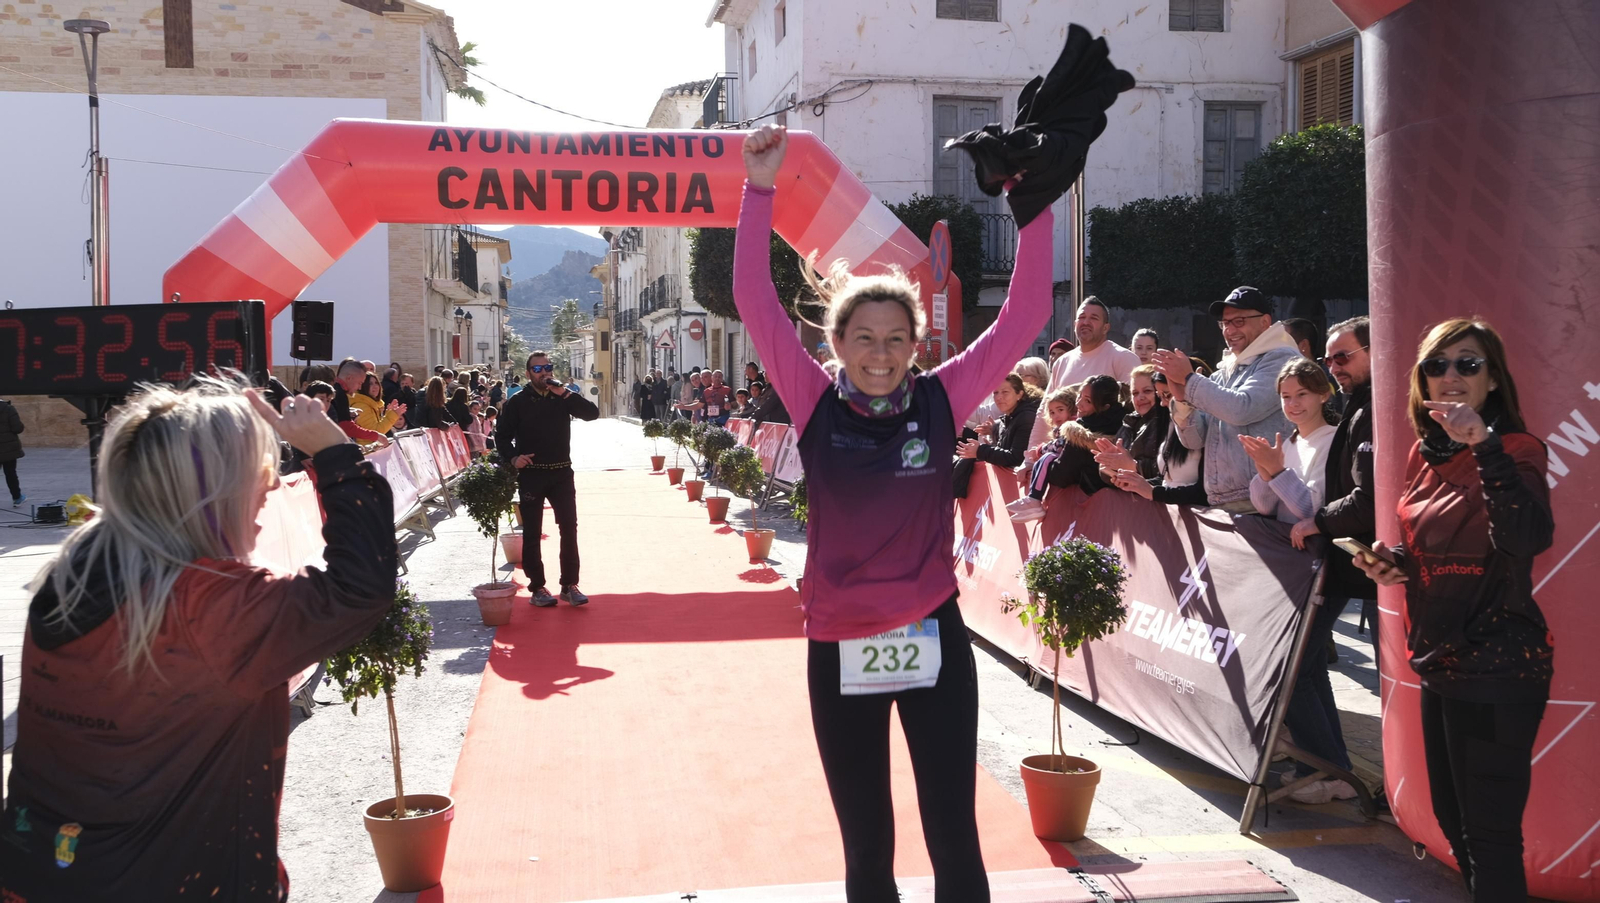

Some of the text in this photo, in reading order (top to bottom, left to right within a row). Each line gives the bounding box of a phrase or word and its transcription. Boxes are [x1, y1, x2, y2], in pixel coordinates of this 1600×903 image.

[428, 128, 724, 158] AYUNTAMIENTO
[437, 166, 715, 214] CANTORIA
[1124, 599, 1247, 668] TEAMERGY
[862, 643, 920, 673] 232
